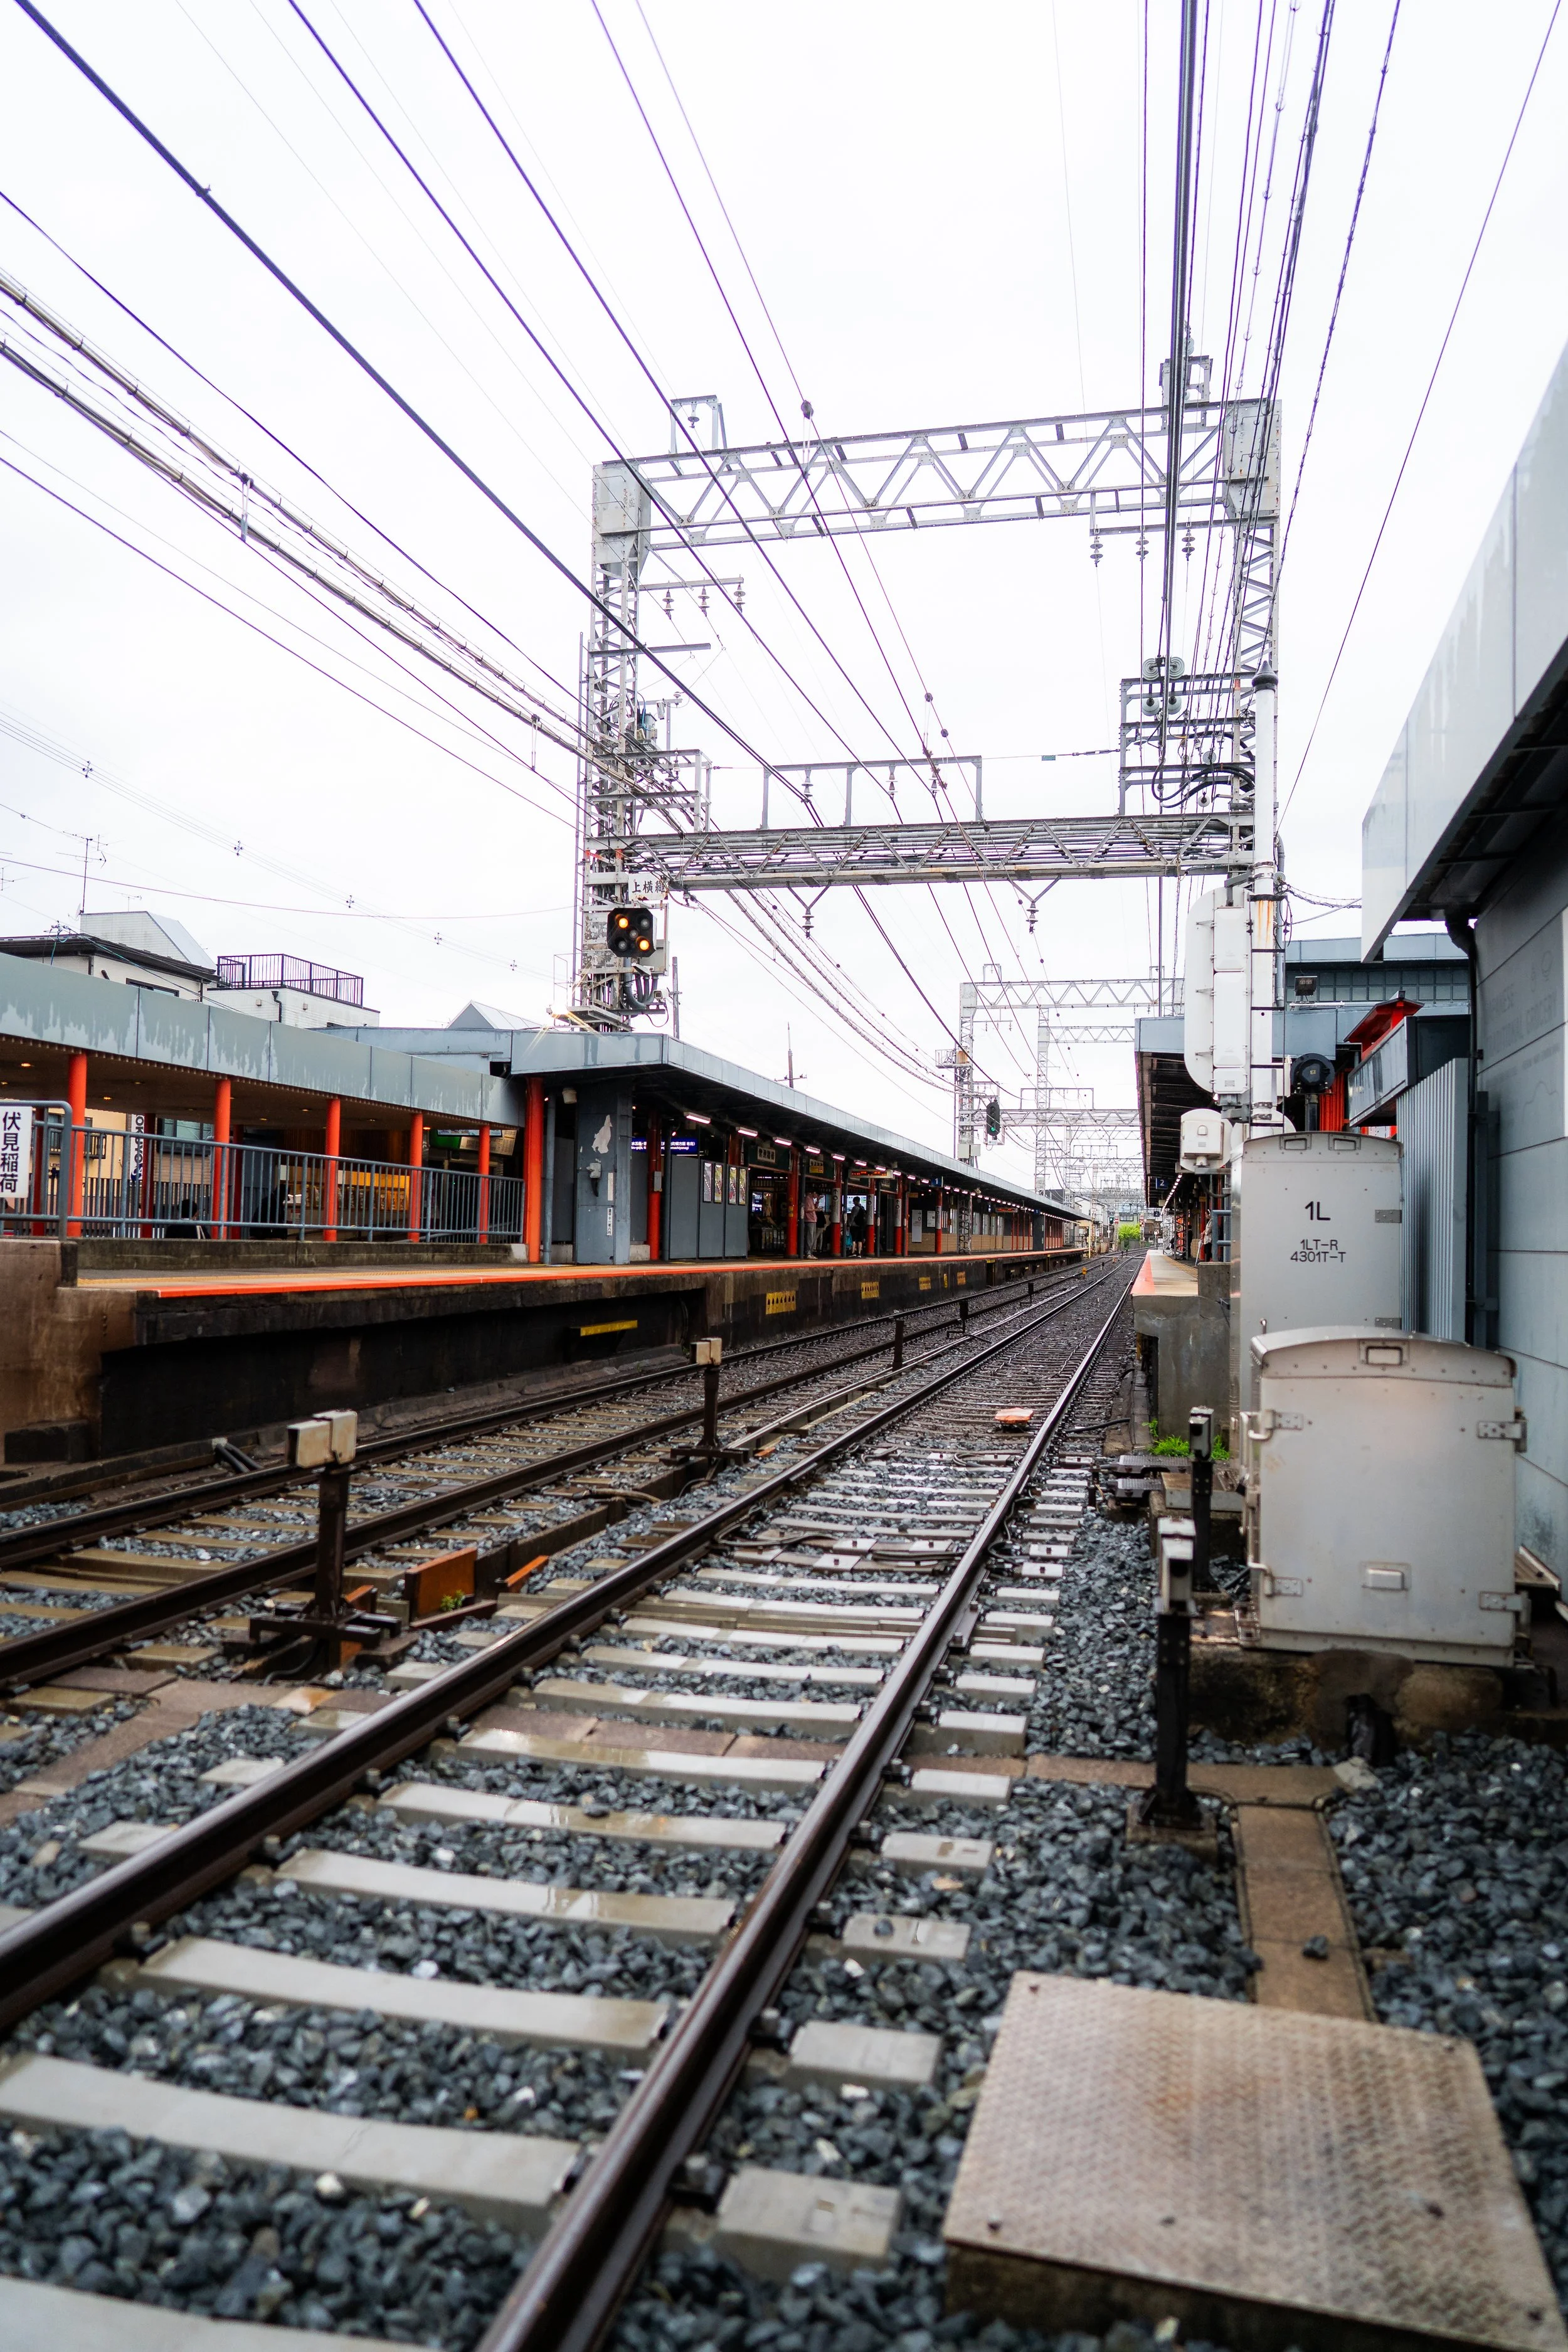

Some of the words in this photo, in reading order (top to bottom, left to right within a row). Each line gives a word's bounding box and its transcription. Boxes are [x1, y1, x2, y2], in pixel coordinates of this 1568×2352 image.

[1, 1111, 21, 1192] 伏見稲荷
[1305, 1201, 1331, 1221] 1L
[1300, 1239, 1338, 1250] 1LT-R
[1290, 1251, 1346, 1262] 4301T-T
